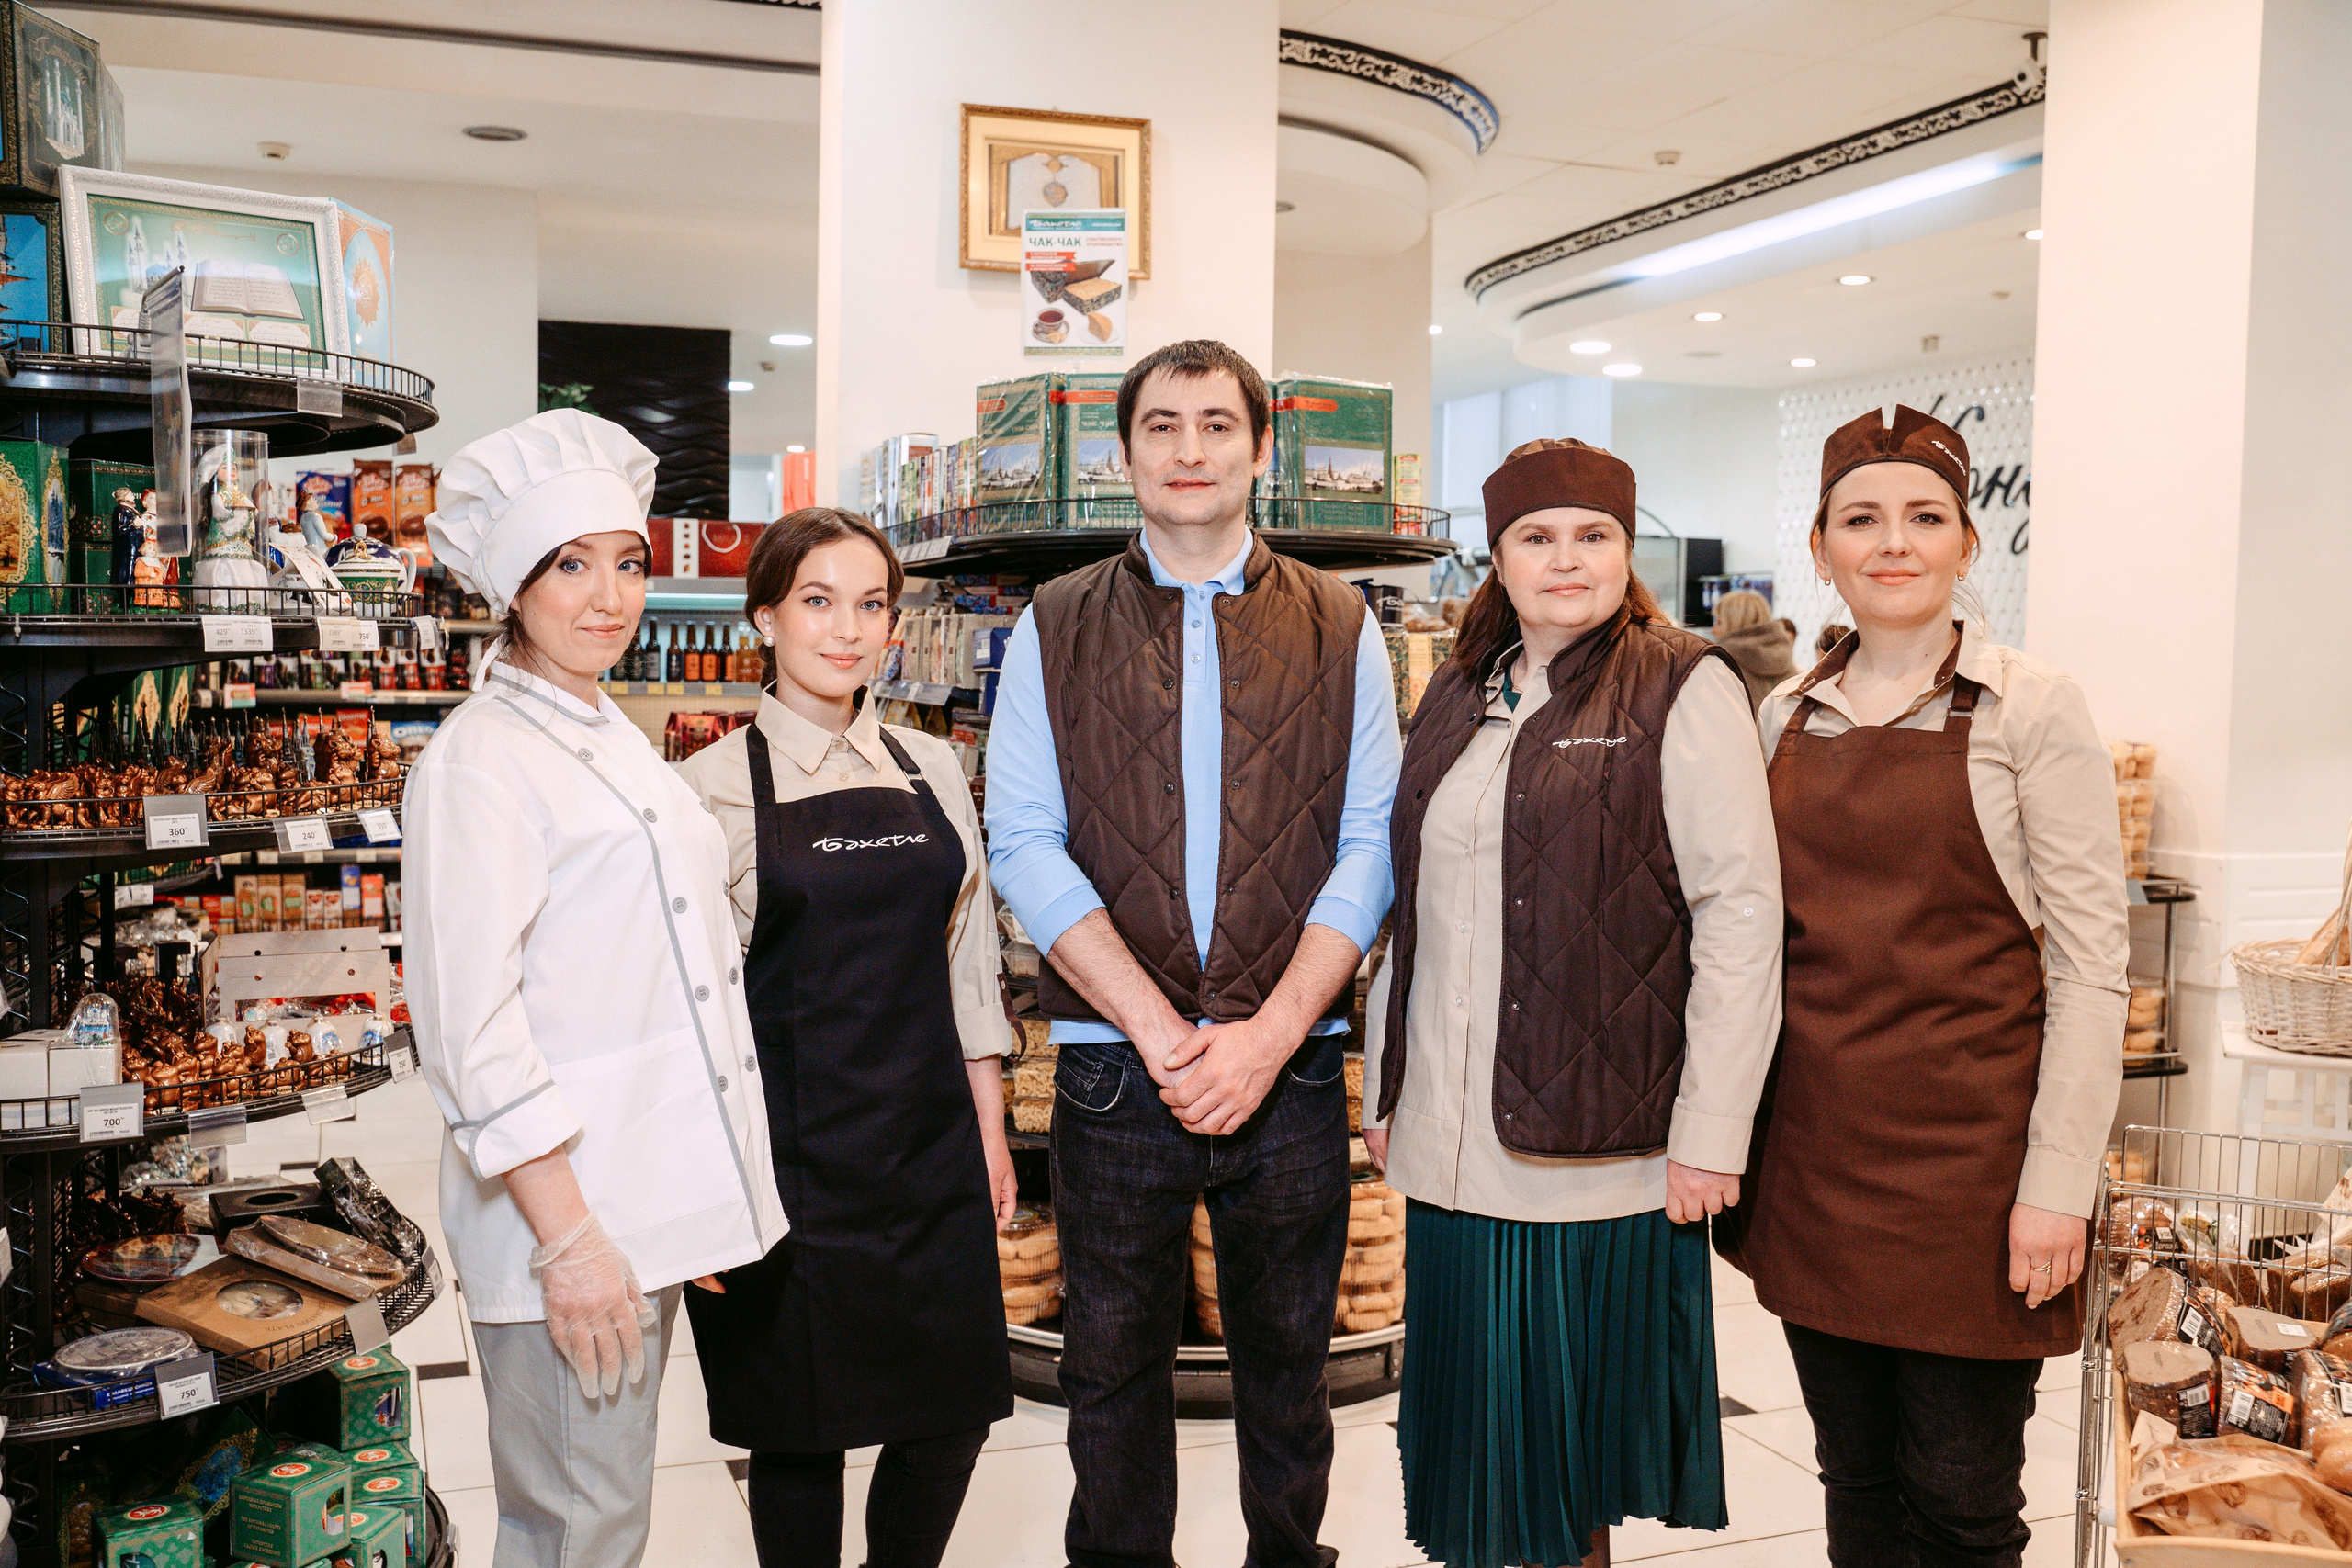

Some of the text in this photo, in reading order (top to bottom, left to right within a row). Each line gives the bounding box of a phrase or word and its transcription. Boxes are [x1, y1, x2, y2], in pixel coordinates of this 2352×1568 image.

[1029, 237, 1082, 246] ЧАК-ЧАК
[169, 828, 185, 836] 360
[104, 1118, 120, 1126] 700
[180, 1389, 196, 1399] 750
